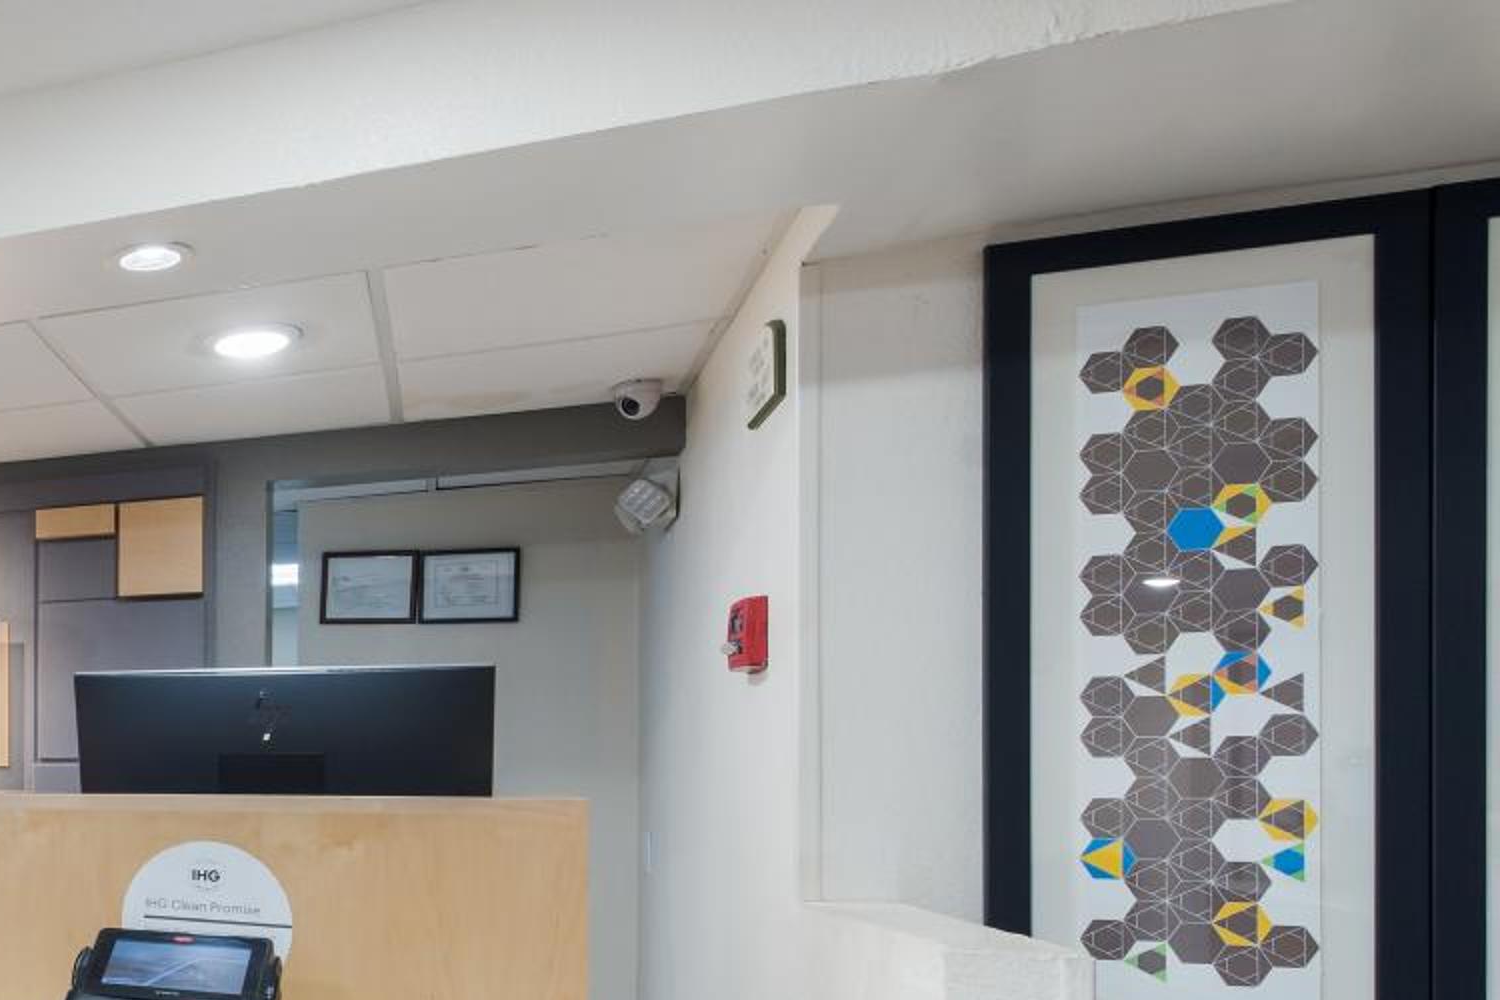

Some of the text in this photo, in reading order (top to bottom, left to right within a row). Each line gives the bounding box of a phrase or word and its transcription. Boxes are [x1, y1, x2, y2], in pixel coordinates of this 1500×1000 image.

[191, 869, 221, 882] IHG
[145, 899, 261, 915] IHG Clean Promise
